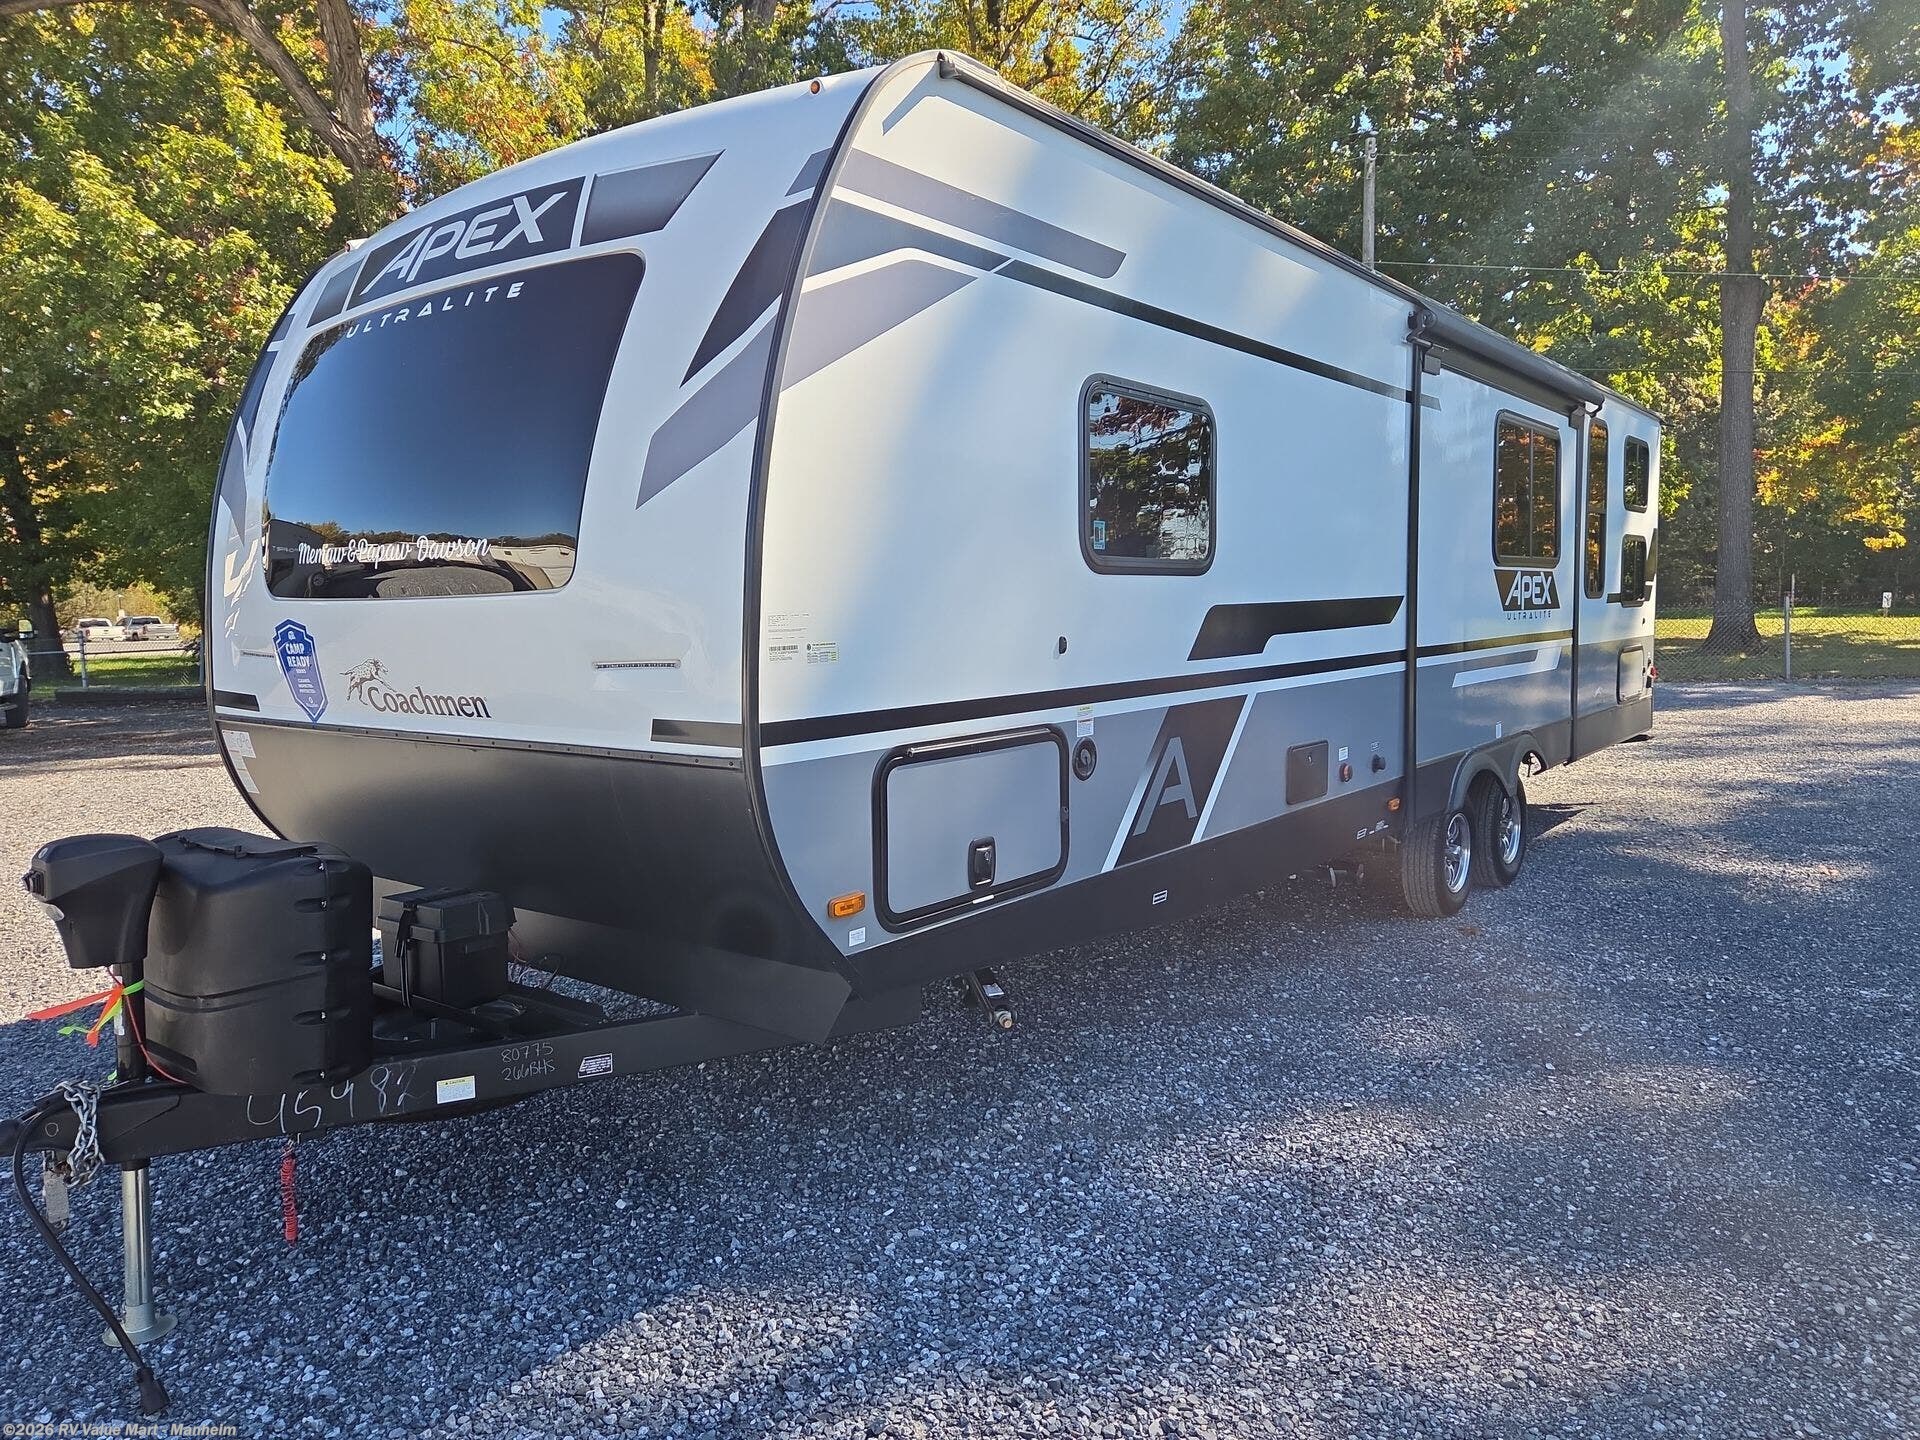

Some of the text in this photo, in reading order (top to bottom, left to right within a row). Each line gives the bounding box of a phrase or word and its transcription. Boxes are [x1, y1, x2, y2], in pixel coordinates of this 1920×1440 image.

[360, 191, 569, 297] APEX
[346, 281, 525, 339] ULTRALITE
[416, 535, 492, 562] Dawson
[1504, 570, 1553, 610] APEX
[1506, 610, 1552, 621] ULTRALITE
[285, 642, 305, 655] CAMP
[287, 655, 310, 668] READY
[367, 686, 492, 719] Coachmen
[501, 1042, 554, 1063] 80775
[501, 1059, 556, 1081] 266BHS
